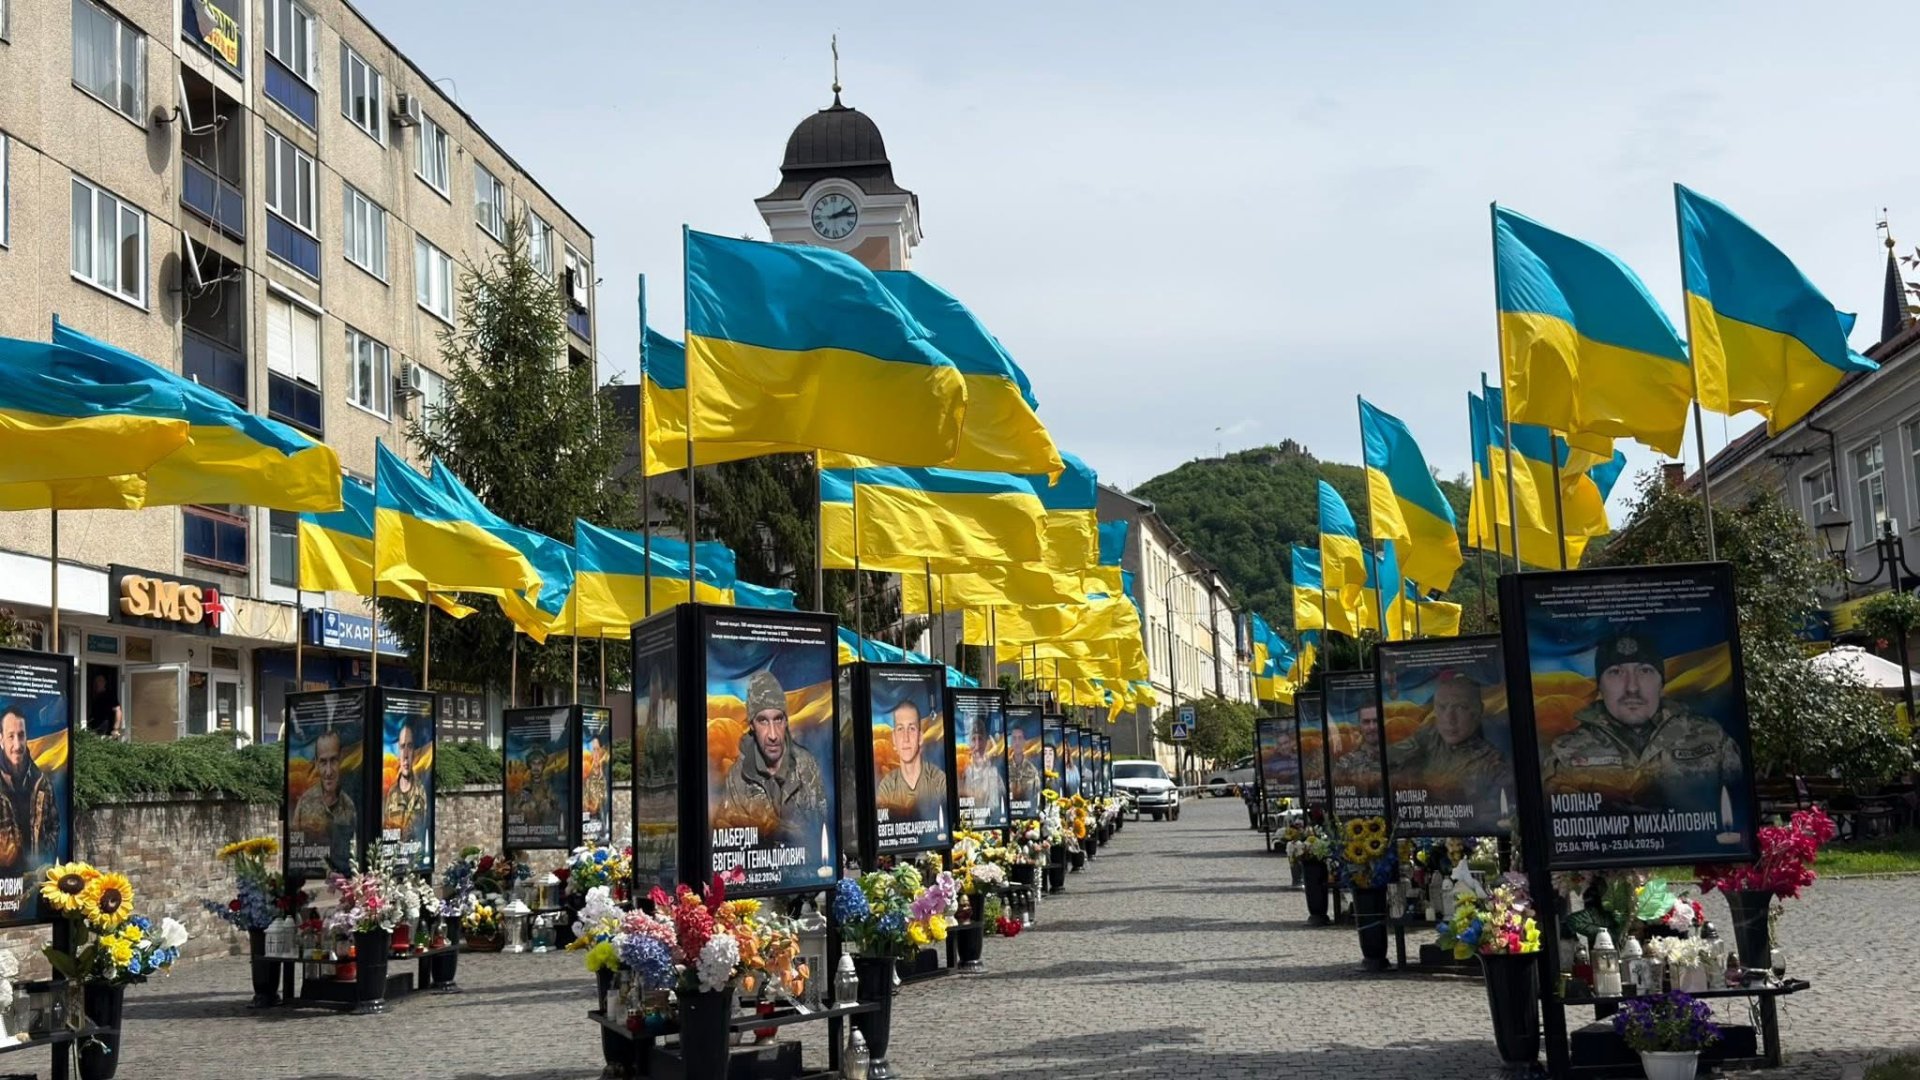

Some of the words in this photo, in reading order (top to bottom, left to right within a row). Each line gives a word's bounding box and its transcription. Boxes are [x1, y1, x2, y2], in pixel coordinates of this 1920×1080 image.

[1395, 790, 1427, 803] МОЛНАР
[1551, 792, 1602, 813] МОЛНАР
[1398, 806, 1422, 818] АРТУР
[1424, 804, 1474, 818] ВАСИЛЬОВИЧ
[1553, 816, 1630, 839] ВОЛОДИМИР
[1633, 809, 1717, 834] МИХАЙЛОВИЧ
[712, 827, 758, 848] АЛАБЕРДІН
[1555, 841, 1600, 854] (25.04.1984
[712, 847, 745, 871] ЄВГЕНІЙ
[748, 844, 805, 870] ГЕННАДІЙОВИЧ
